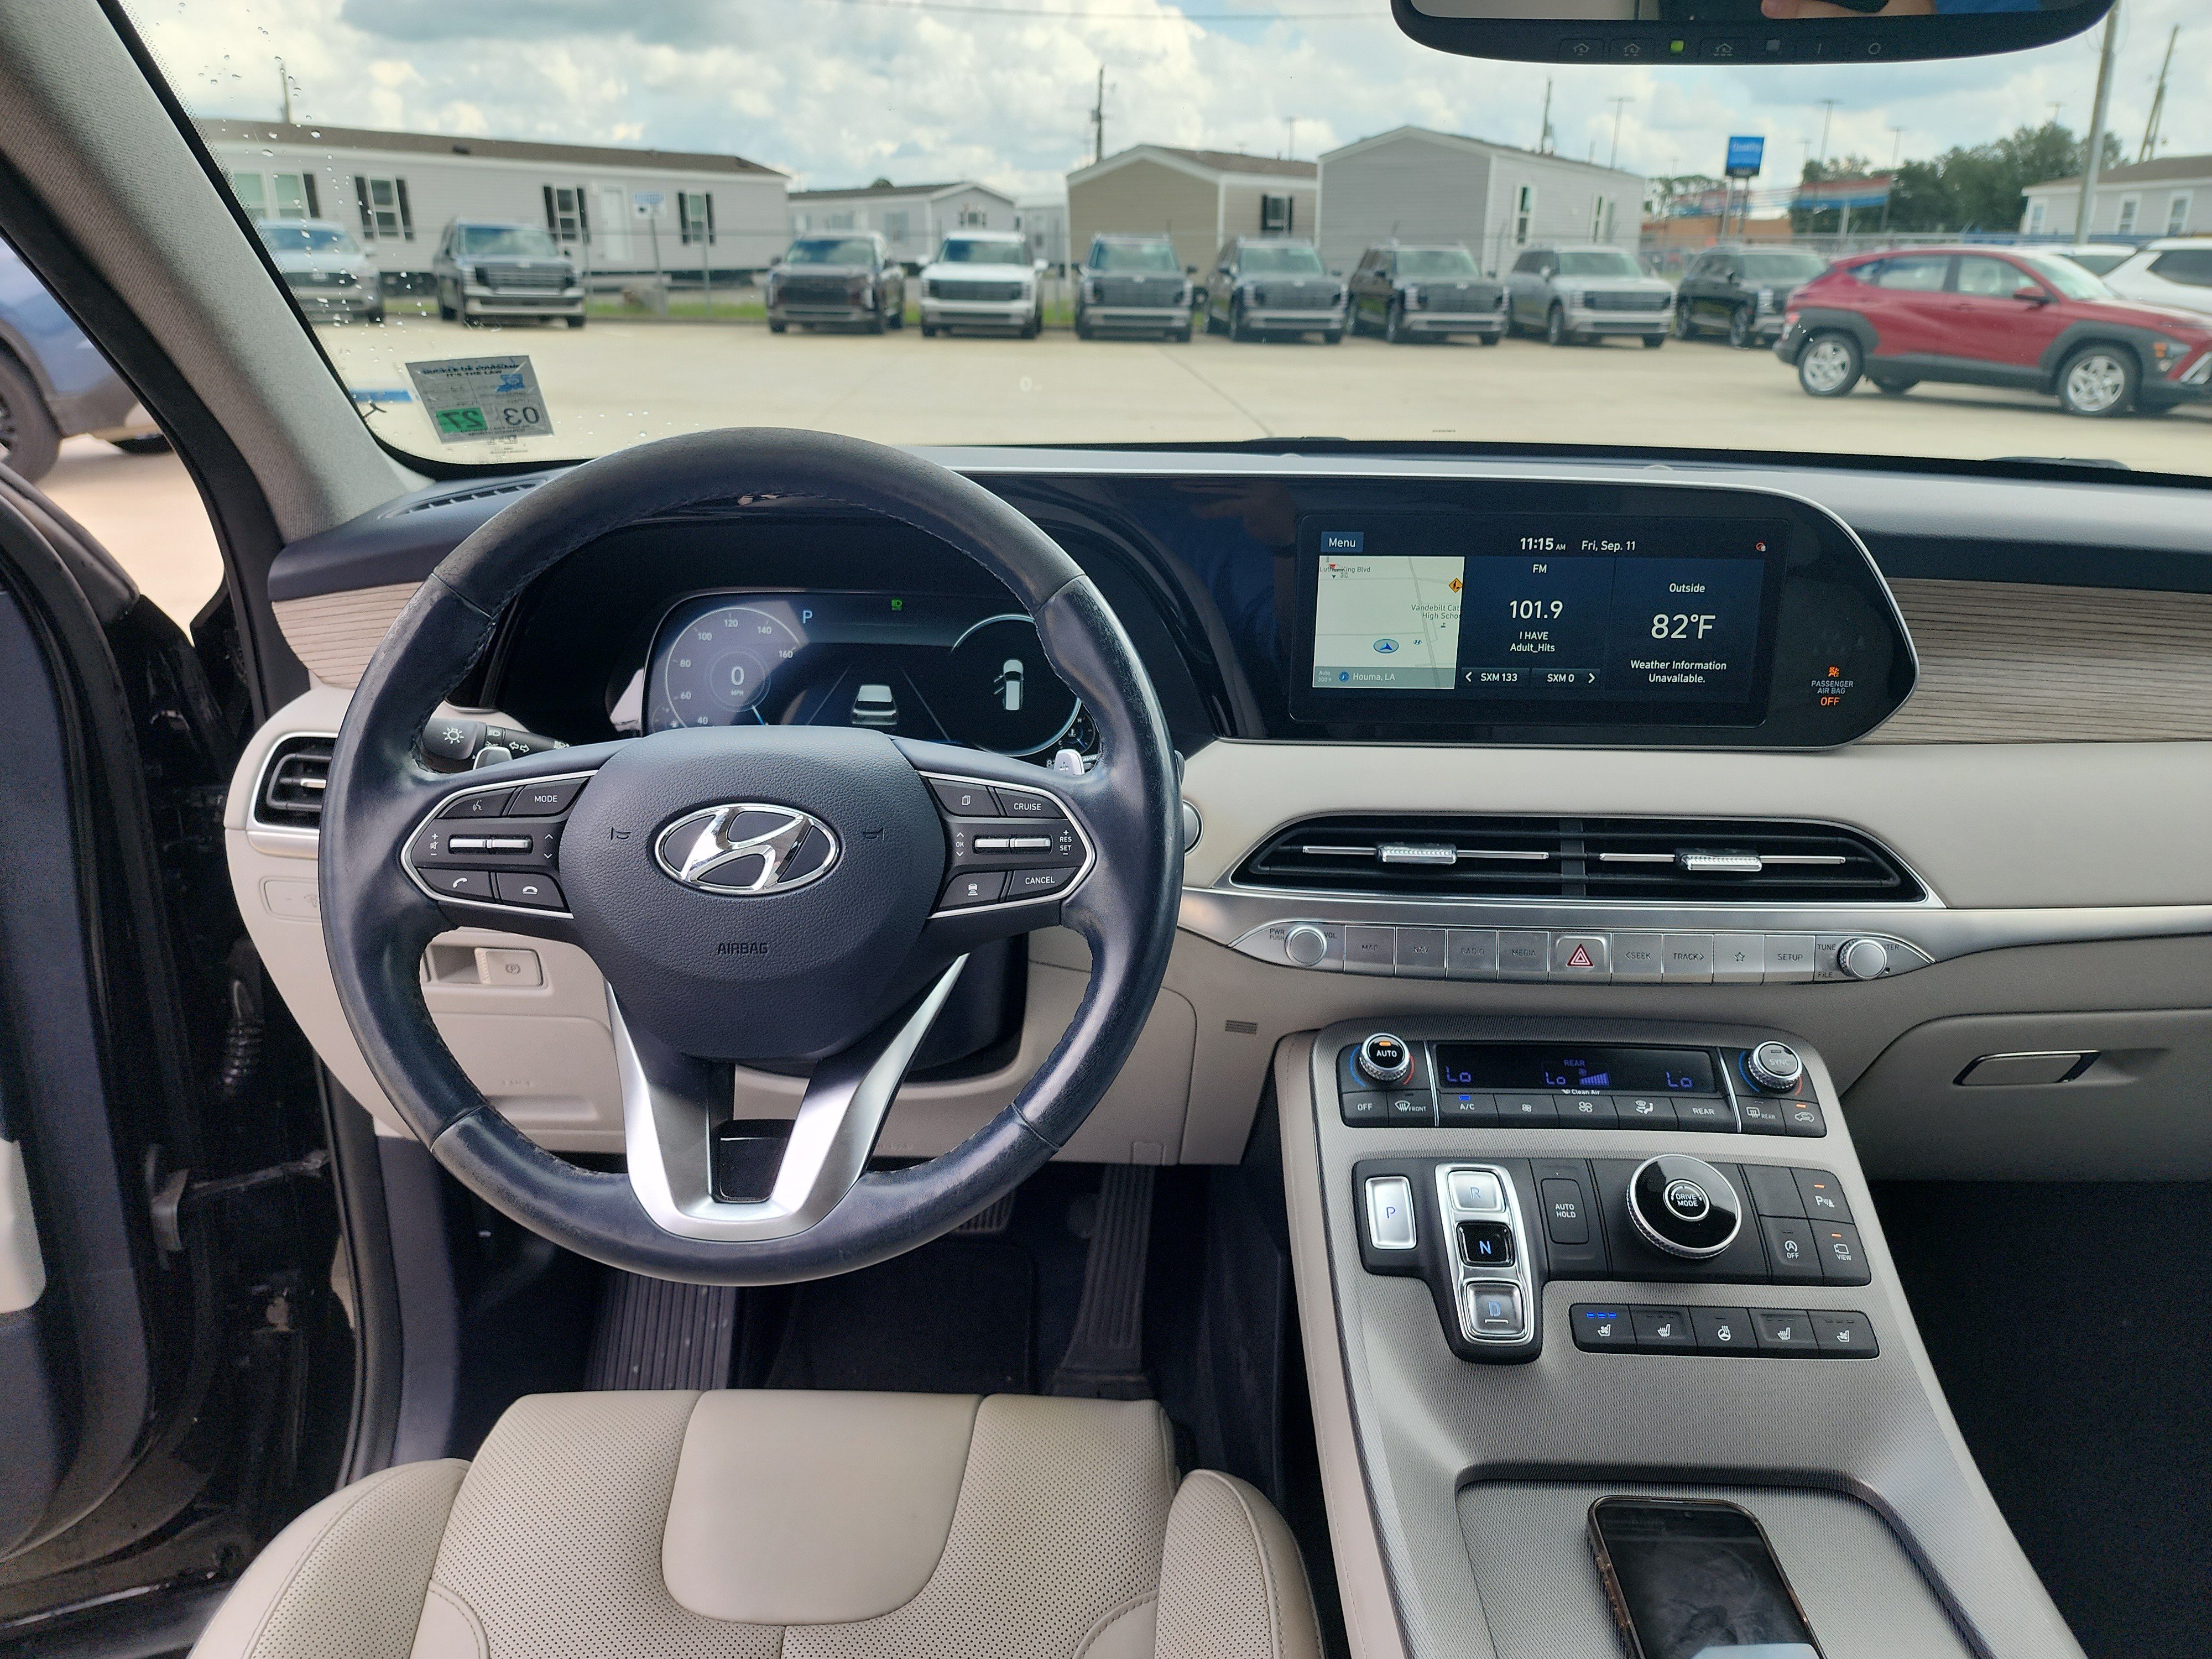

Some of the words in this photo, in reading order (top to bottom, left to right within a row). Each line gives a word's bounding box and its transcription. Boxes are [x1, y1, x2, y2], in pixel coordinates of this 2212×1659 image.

[1329, 538, 1356, 547] Menu
[1520, 538, 1554, 550] 11:15
[1582, 540, 1598, 551] Fri,
[1601, 541, 1623, 552] Sep.
[1626, 541, 1636, 551] 11
[1532, 564, 1547, 573] FM
[1669, 583, 1705, 593] Outside
[1510, 600, 1563, 619] 101.9
[802, 610, 813, 624] P
[724, 619, 738, 628] 120
[1651, 614, 1716, 639] 82°F
[758, 627, 772, 635] 140
[697, 633, 712, 641] 100
[1520, 632, 1522, 640] I
[1525, 632, 1549, 640] HAVE
[1510, 643, 1556, 653] Adult_Hits
[779, 650, 794, 659] 160
[1631, 660, 1670, 669] Weather
[1672, 660, 1726, 670] Information
[731, 666, 744, 685] 0
[1480, 673, 1500, 681] SXM
[1501, 673, 1517, 681] 133
[1547, 674, 1566, 682] SXM
[1648, 674, 1705, 683] Unavailable.
[680, 692, 691, 700] 60
[1820, 697, 1840, 706] OFF
[697, 716, 708, 725] 40
[717, 942, 768, 954] AIRBAG
[1564, 1059, 1585, 1067] REAR
[1470, 1187, 1481, 1199] R
[1386, 1207, 1396, 1219] P
[1479, 1240, 1491, 1255] N
[1488, 1301, 1501, 1317] D
